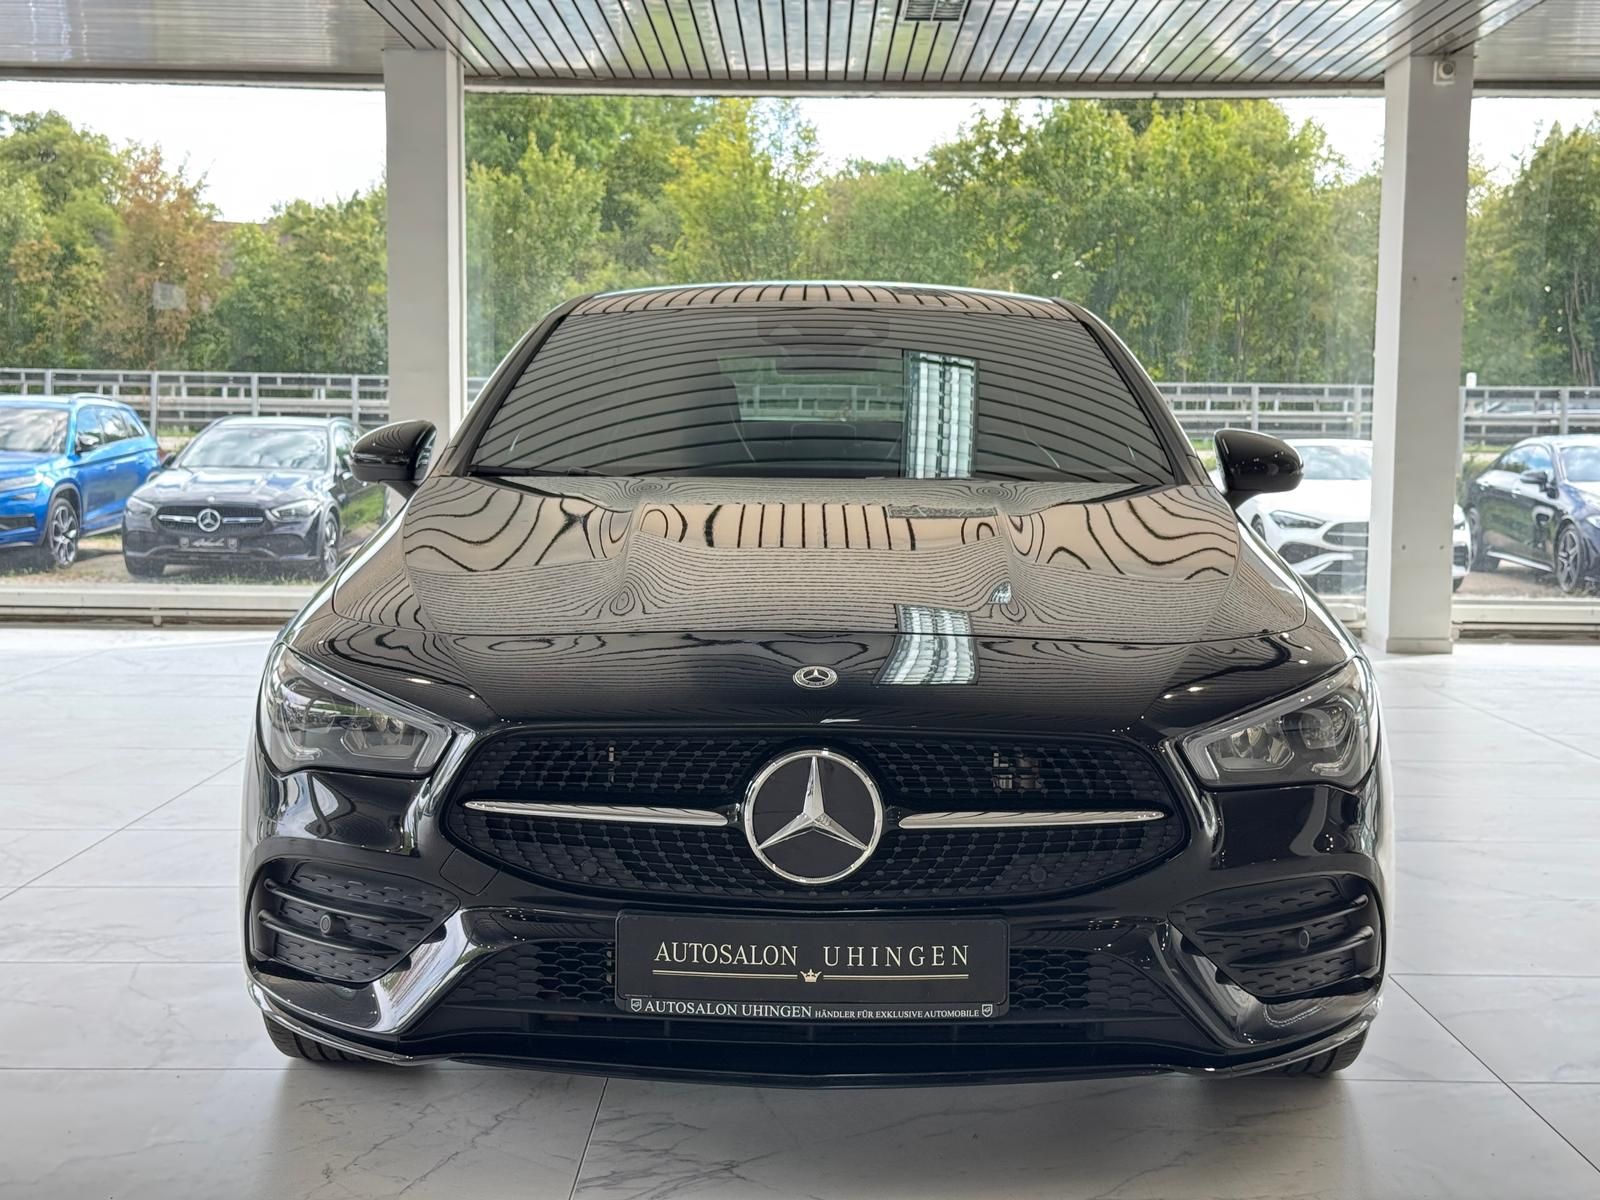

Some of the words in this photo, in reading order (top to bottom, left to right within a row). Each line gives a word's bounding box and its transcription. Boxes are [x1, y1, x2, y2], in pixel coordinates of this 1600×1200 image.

[654, 941, 798, 966] AUTOSALON
[823, 945, 969, 967] UHINGEN
[644, 1000, 738, 1016] AUTOSALON
[742, 1004, 812, 1018] UHINGEN
[815, 1009, 855, 1018] HÄNDLER
[857, 1009, 875, 1018] FÜR
[875, 1010, 923, 1018] EXKLUSIVE
[923, 1009, 980, 1018] AUTOMOBILE
